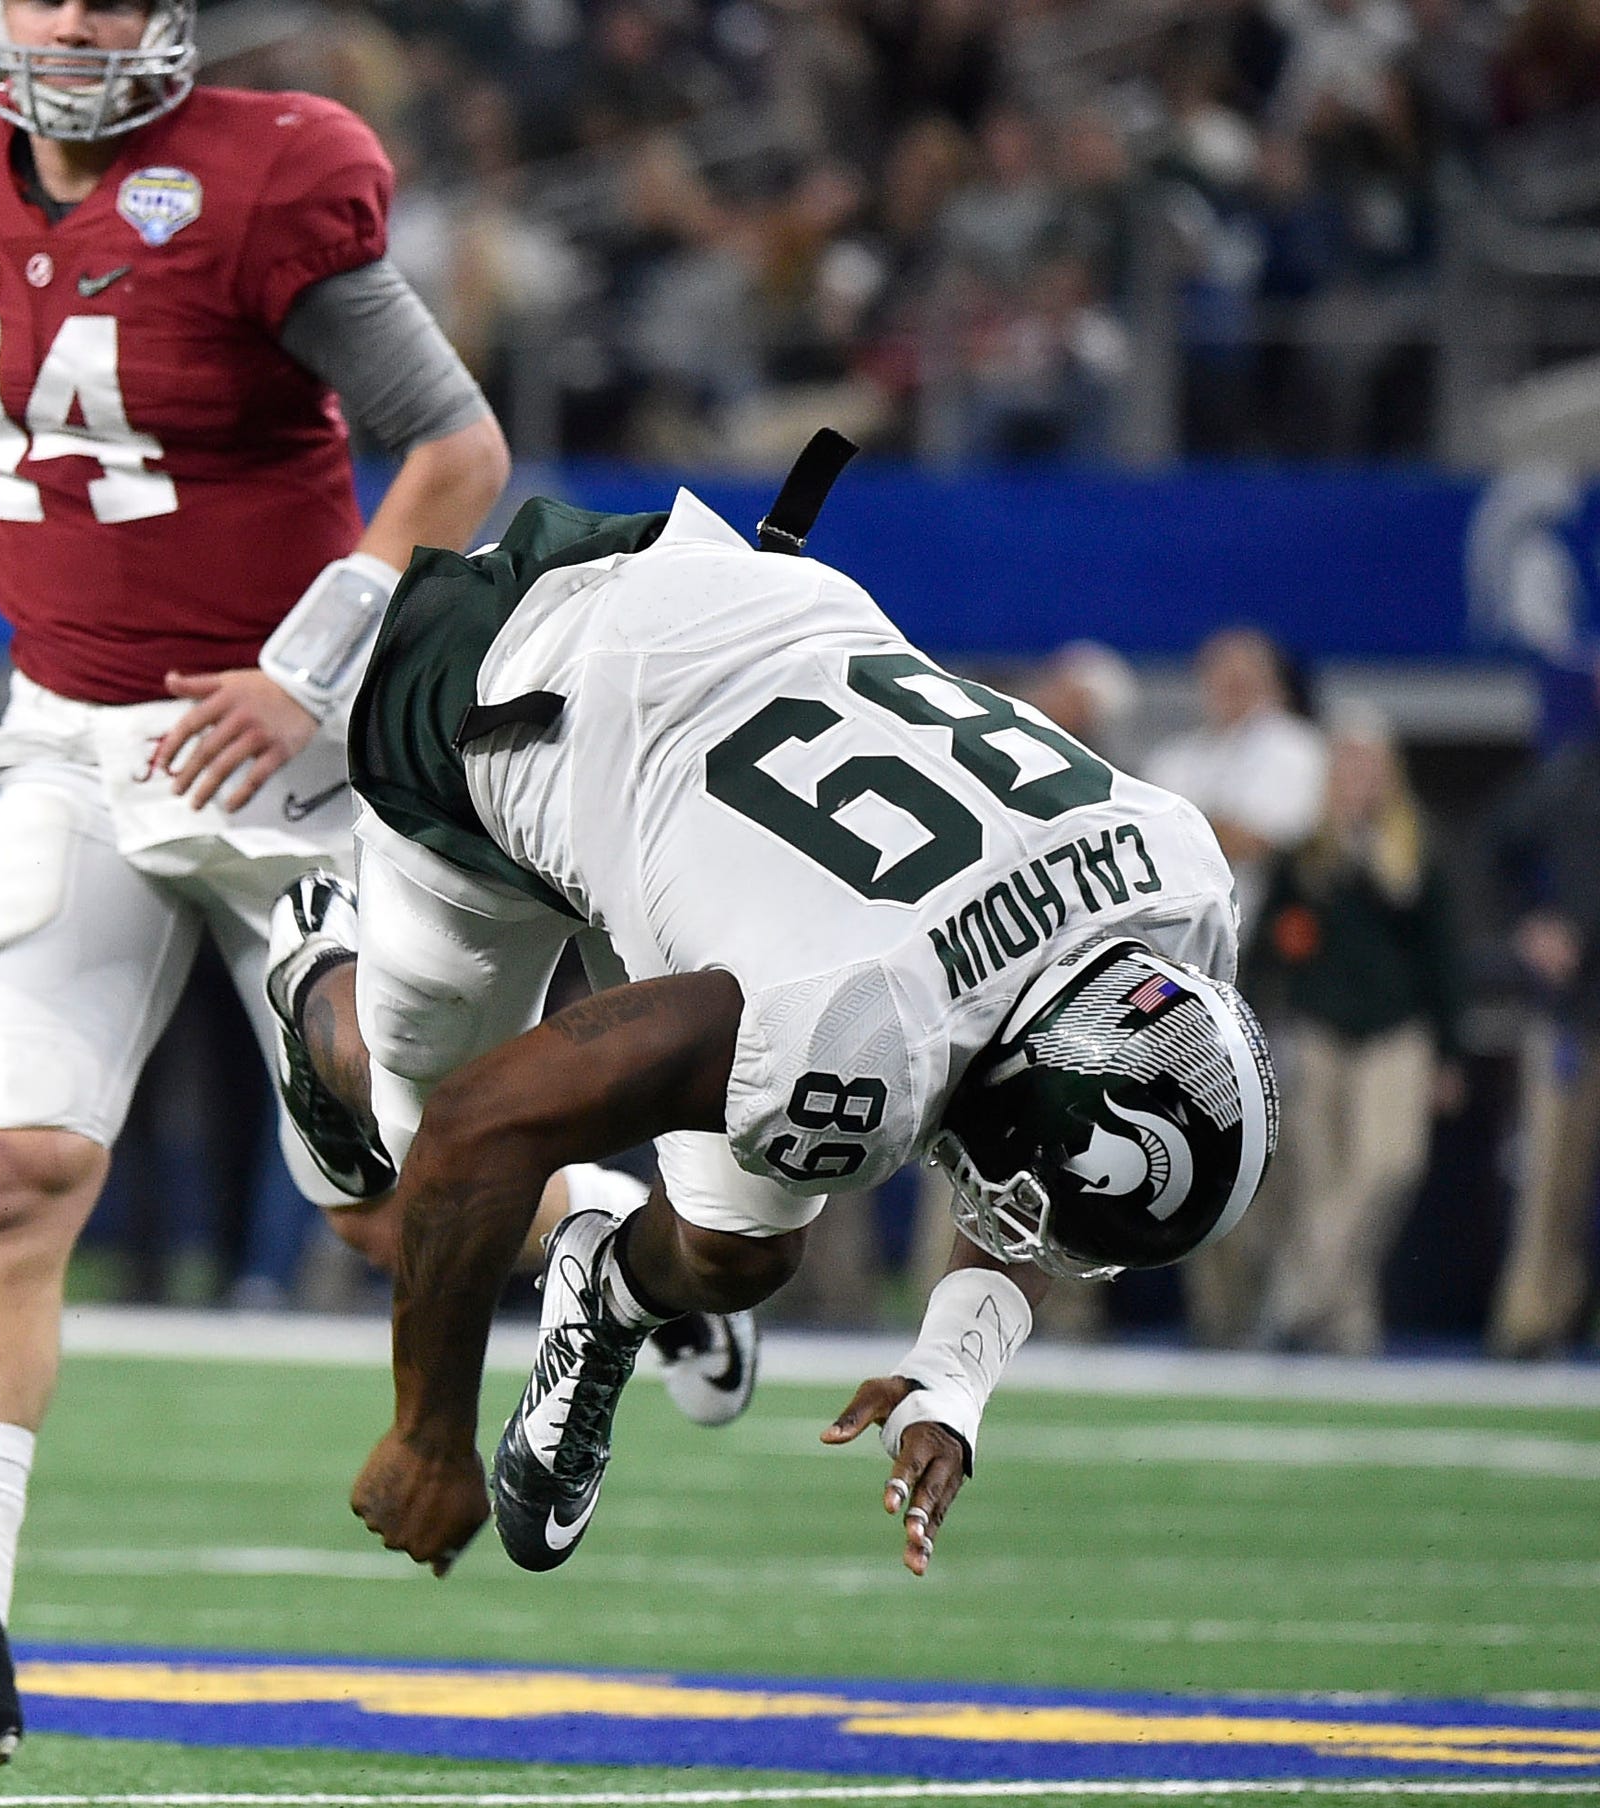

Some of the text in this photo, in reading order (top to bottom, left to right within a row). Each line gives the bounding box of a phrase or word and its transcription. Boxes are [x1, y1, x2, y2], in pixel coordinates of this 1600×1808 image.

[706, 654, 1114, 905] 89
[928, 824, 1162, 999] CALHOUN
[764, 1071, 888, 1181] 89
